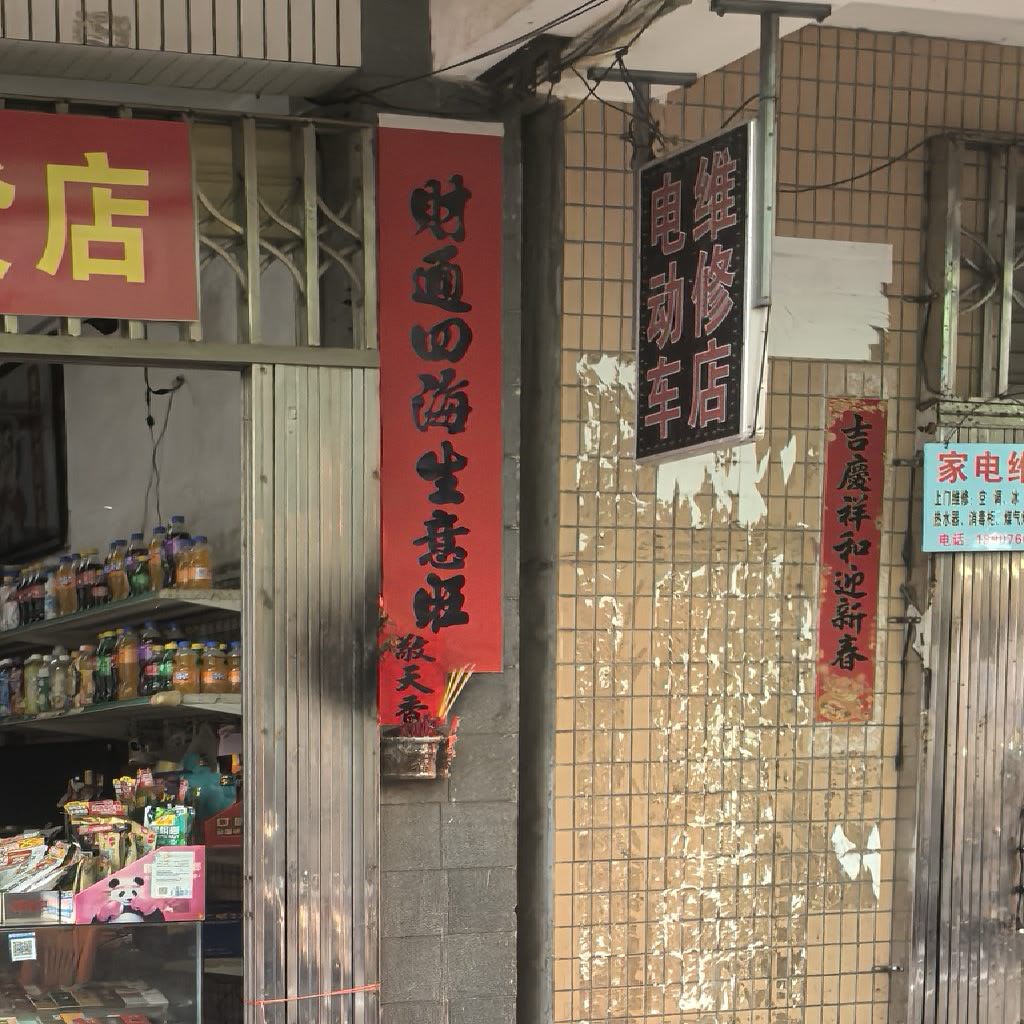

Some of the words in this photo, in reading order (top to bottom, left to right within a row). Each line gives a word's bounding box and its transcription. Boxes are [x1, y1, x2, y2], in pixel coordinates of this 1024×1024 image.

[410, 174, 473, 635] 財通四海生意旺
[644, 172, 687, 440] 电动车
[687, 146, 737, 429] 维修店
[830, 413, 874, 672] 吉慶祥和迎新春
